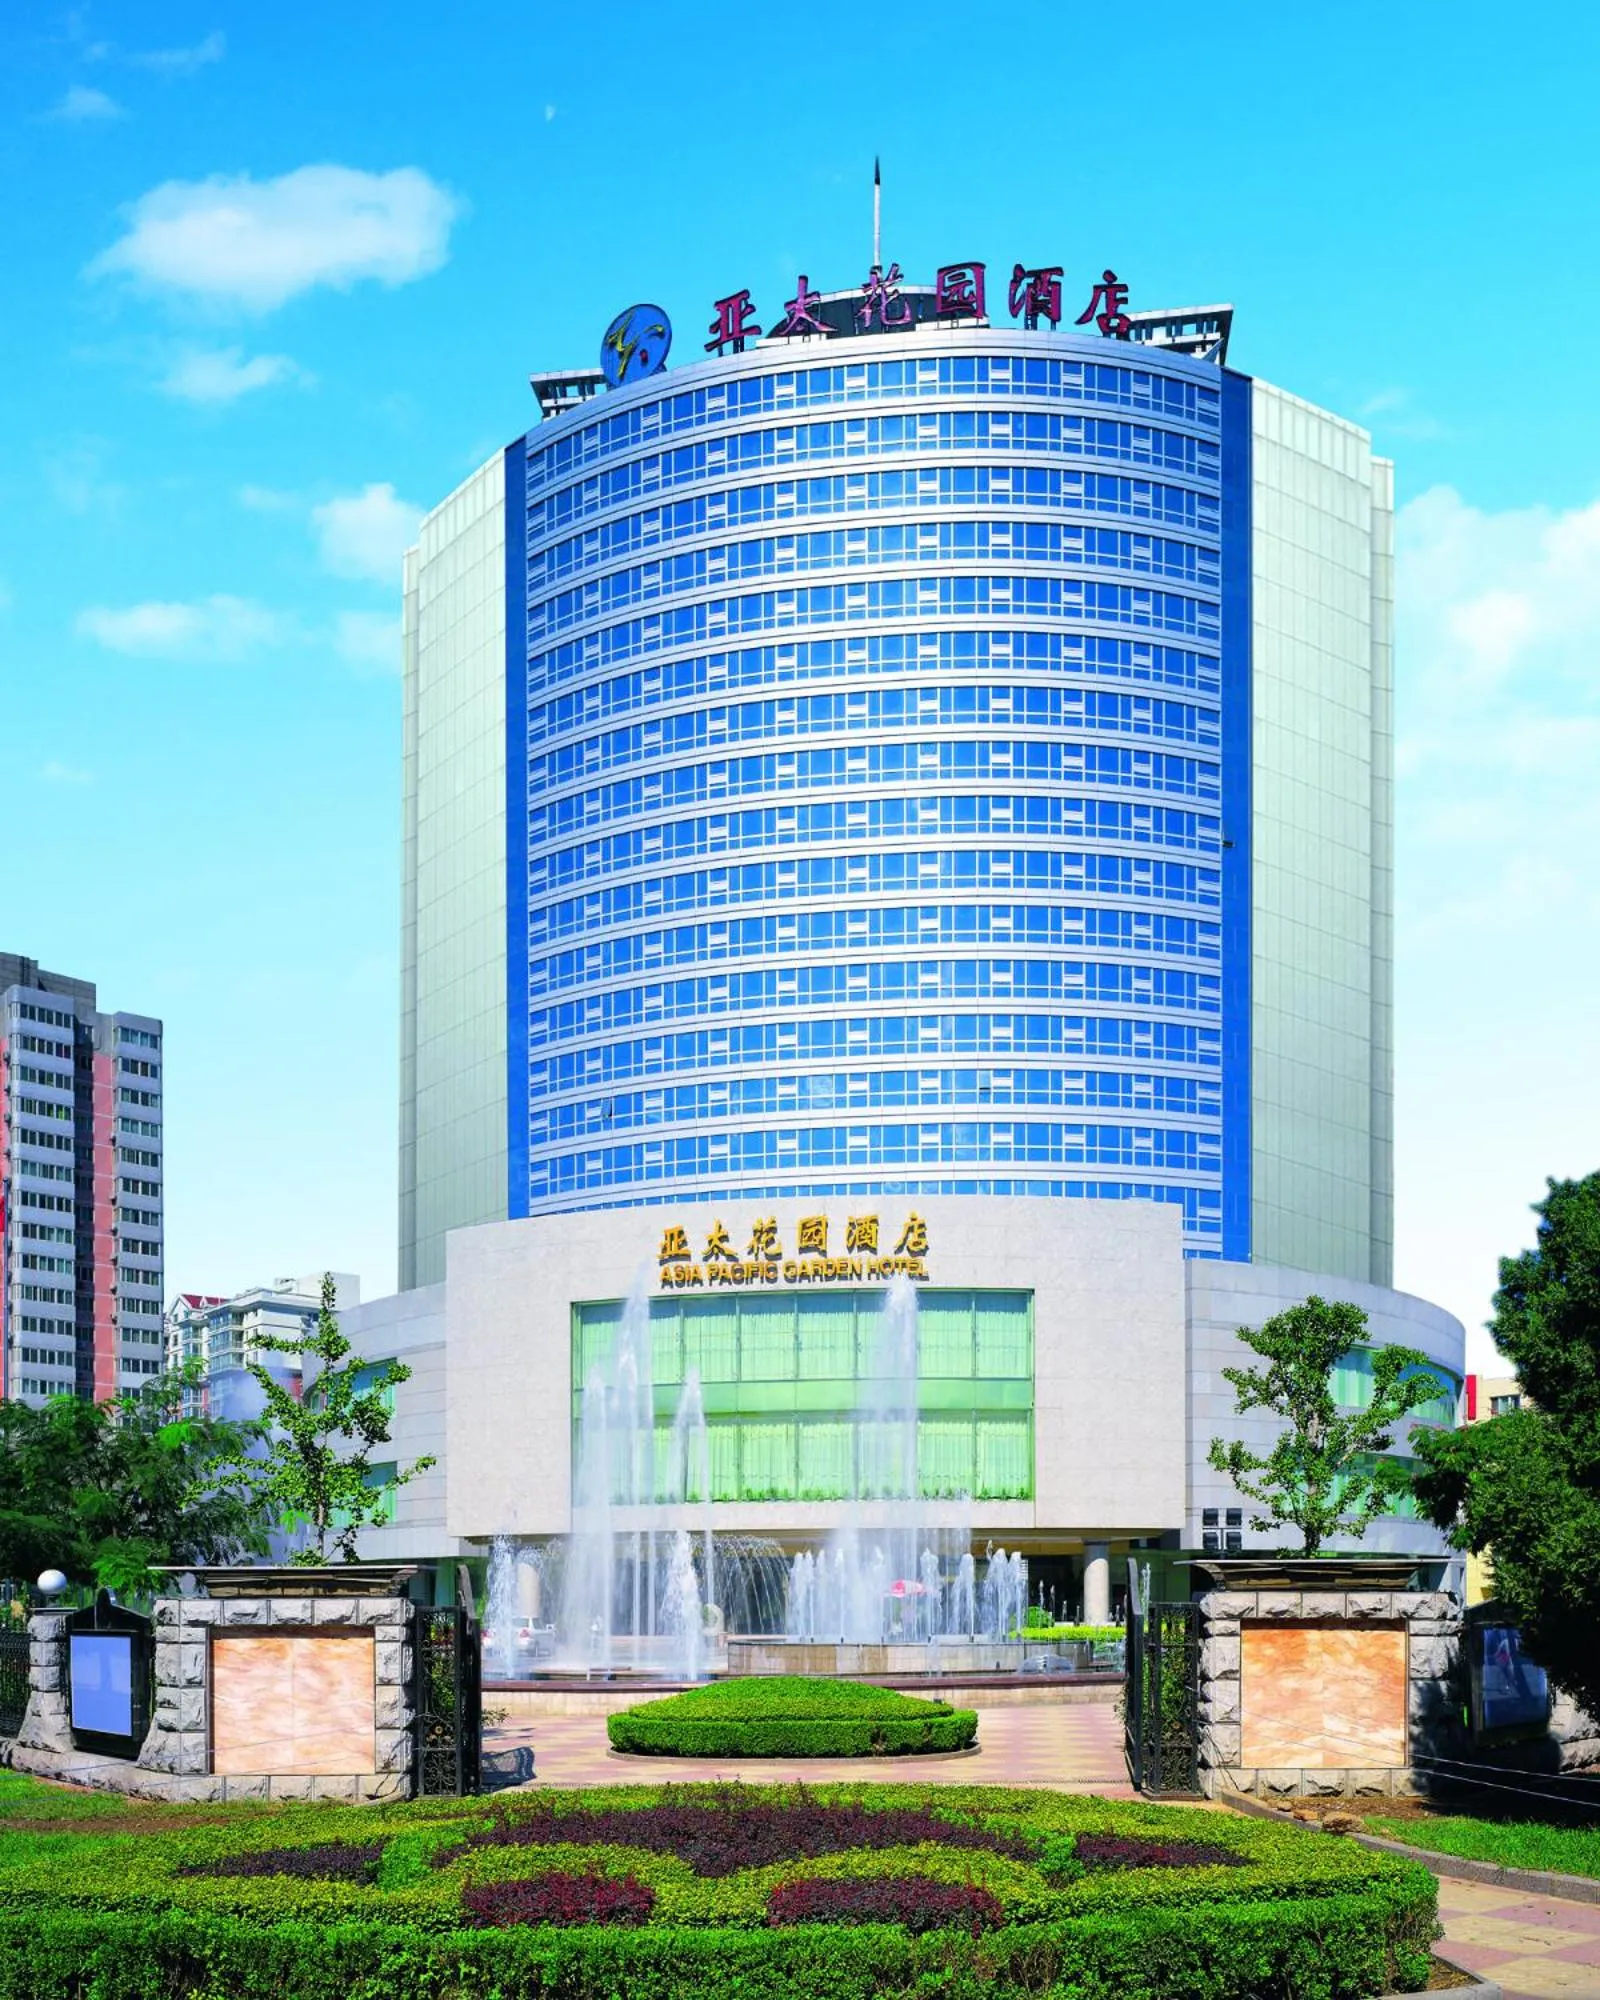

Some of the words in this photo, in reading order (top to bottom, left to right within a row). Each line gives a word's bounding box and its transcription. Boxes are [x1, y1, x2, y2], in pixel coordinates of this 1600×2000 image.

[703, 262, 1130, 352] 亚太花园酒店
[658, 1210, 928, 1260] 亚太花园酒店
[660, 1264, 702, 1285] ASIA
[706, 1260, 778, 1282] PACIFIC
[783, 1257, 863, 1280] GARDEN
[866, 1256, 928, 1278] HOTEL
